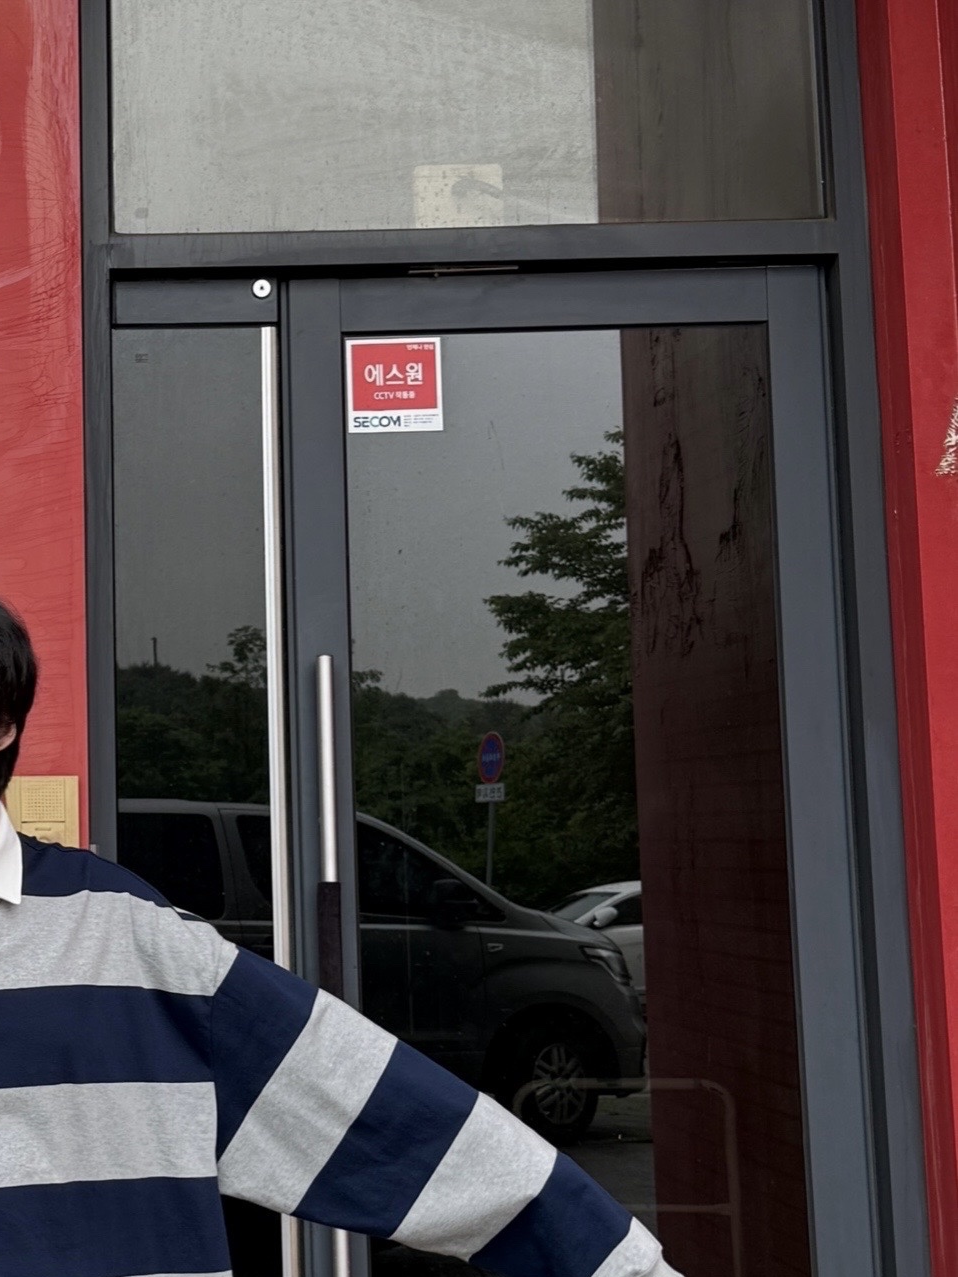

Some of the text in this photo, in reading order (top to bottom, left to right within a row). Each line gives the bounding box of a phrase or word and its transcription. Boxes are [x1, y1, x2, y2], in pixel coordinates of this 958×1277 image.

[364, 362, 423, 386] 에스원
[373, 391, 394, 400] CCTV
[353, 416, 401, 428] SECOM
